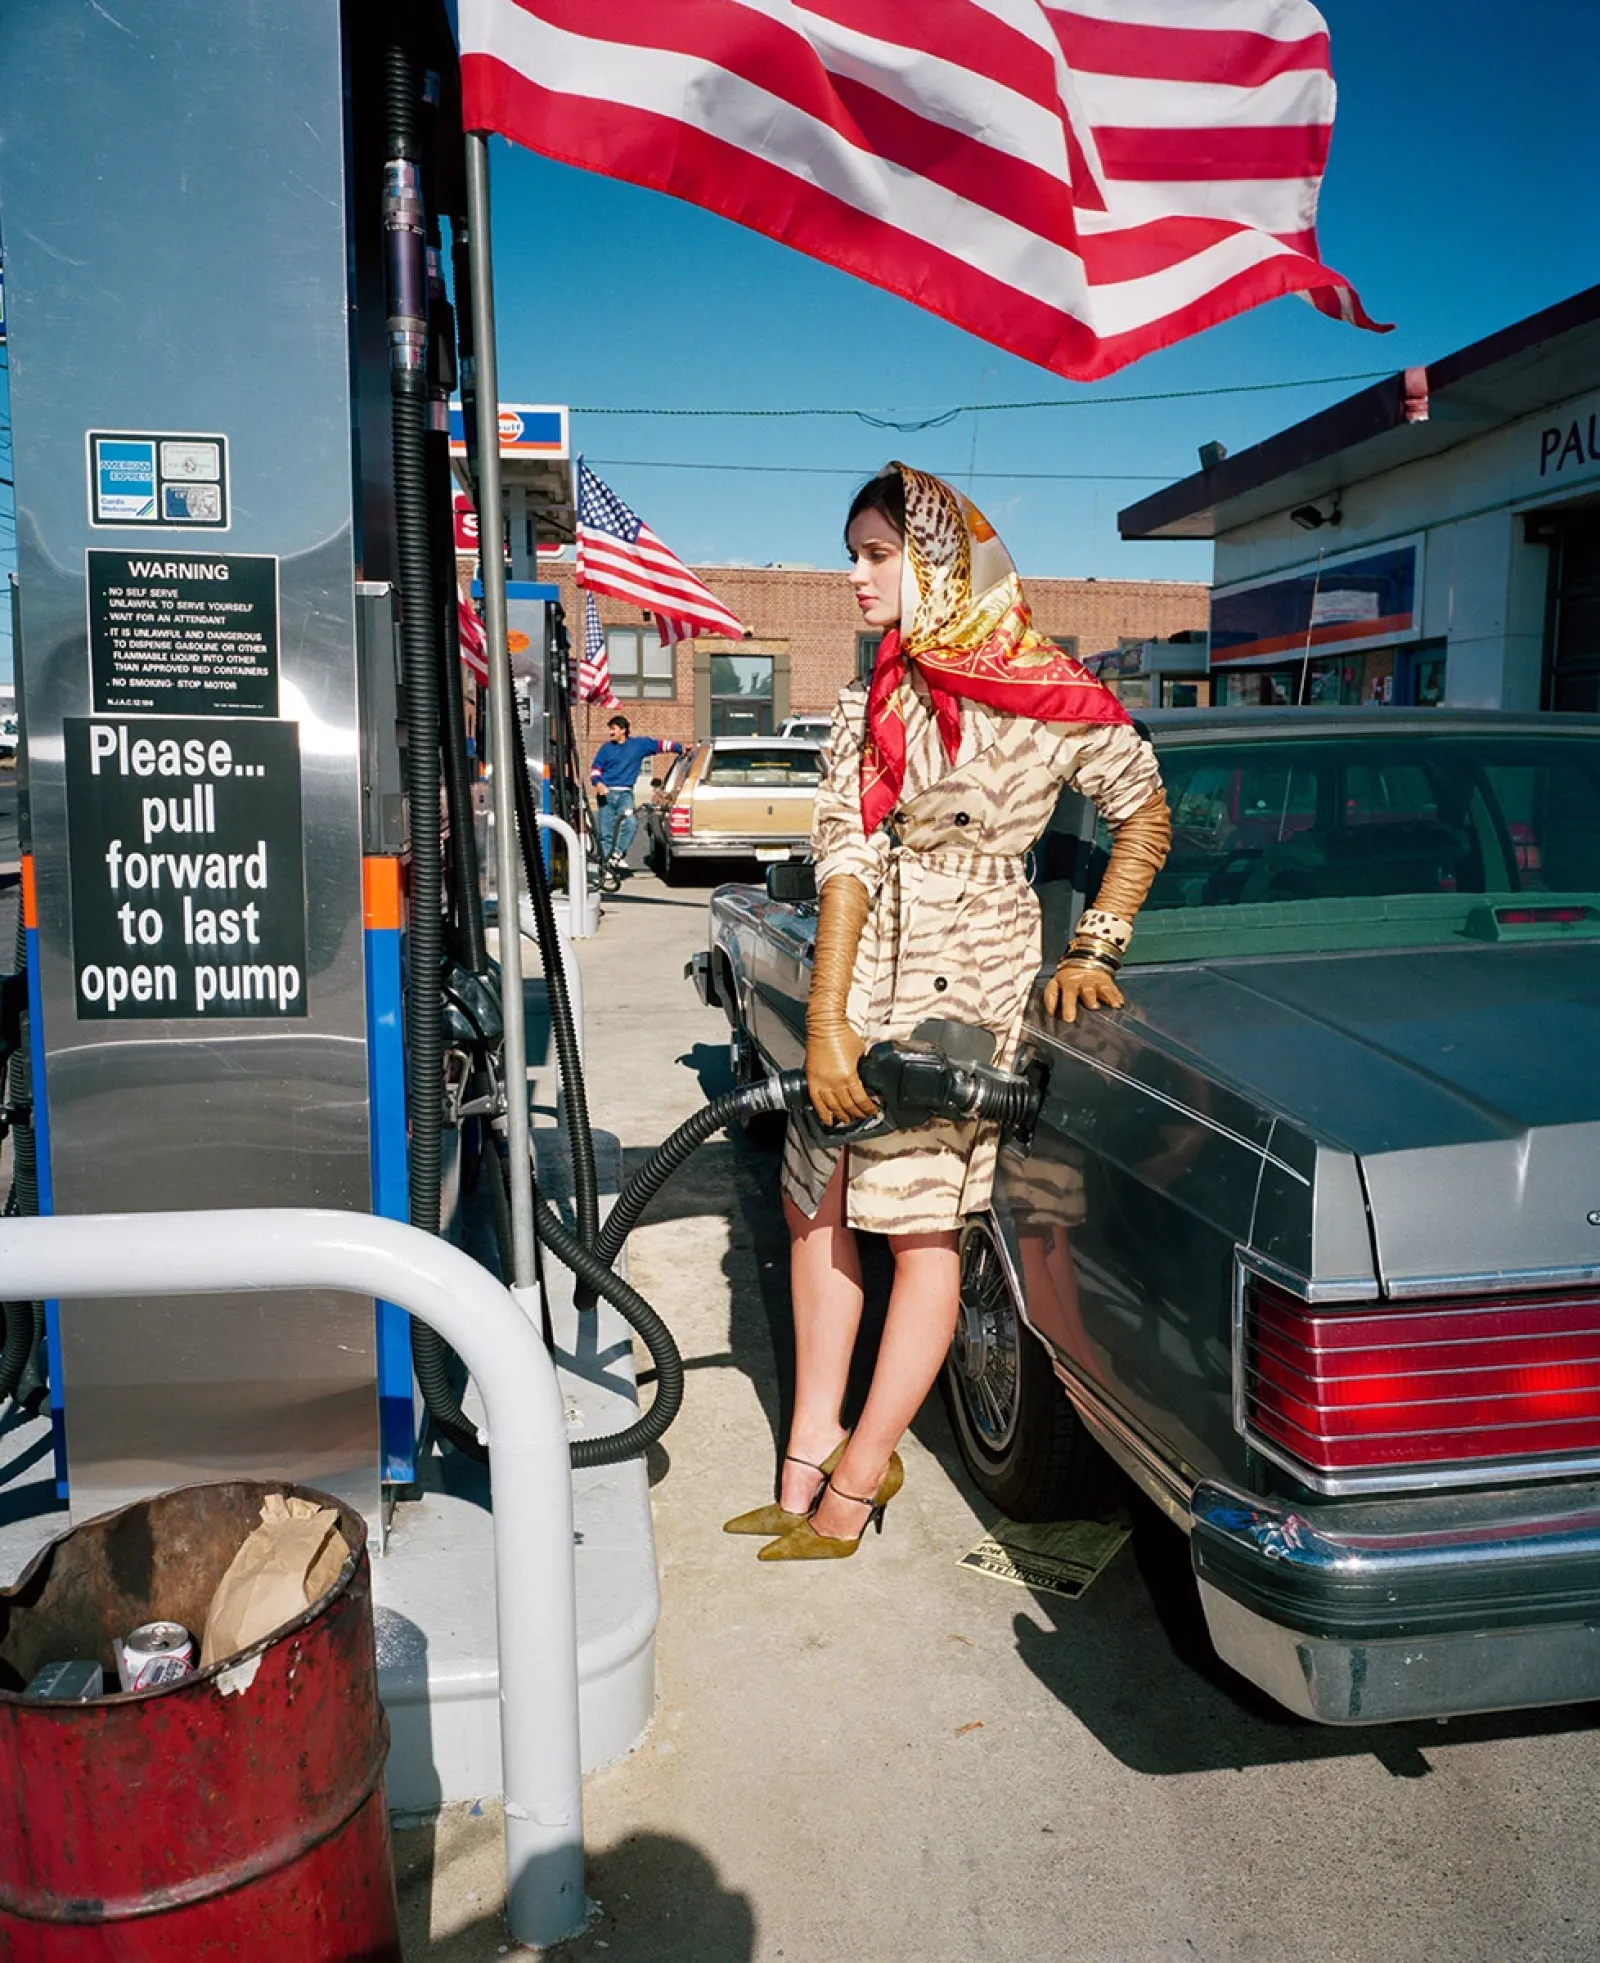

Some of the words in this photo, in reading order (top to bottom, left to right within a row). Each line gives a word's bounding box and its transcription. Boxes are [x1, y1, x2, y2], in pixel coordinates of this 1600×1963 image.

[100, 461, 151, 470] AMERICAN
[128, 560, 229, 581] WARNING
[108, 587, 123, 596] NO
[125, 587, 147, 597] SELF
[149, 588, 178, 598] SERVE
[109, 598, 158, 609] UNLAWFUL
[160, 600, 174, 609] TO
[176, 601, 205, 611] SERVE
[207, 602, 254, 613] YOURSELF
[109, 612, 134, 621] WAIT
[135, 613, 154, 622] FOR
[156, 614, 171, 623] AN
[173, 614, 226, 625] ATTENDANT
[110, 627, 118, 636] IT
[121, 627, 131, 636] IS
[133, 628, 182, 639] UNLAWFUL
[184, 630, 204, 640] AND
[207, 631, 262, 642] DANGEROUS
[113, 639, 126, 648] TO
[128, 639, 172, 650] DISPENSE
[174, 641, 219, 652] GASOLINE
[221, 643, 235, 652] OR
[237, 644, 267, 654] OTHER
[113, 650, 168, 661] FLAMMABLE
[170, 652, 200, 662] LIQUID
[202, 653, 224, 663] INTO
[226, 654, 256, 665] OTHER
[114, 662, 139, 672] THAN
[141, 663, 190, 674] APPROVED
[192, 665, 211, 675] RED
[212, 665, 269, 677] CONTAINERS
[112, 677, 126, 687] NO
[177, 679, 201, 689] STOP
[203, 680, 237, 690] MOTOR
[90, 725, 265, 776] Please...
[143, 784, 215, 844] pull
[106, 840, 268, 889] forward
[117, 902, 163, 944] to
[183, 895, 260, 944] last
[81, 964, 177, 1011] open
[195, 964, 300, 1011] pump
